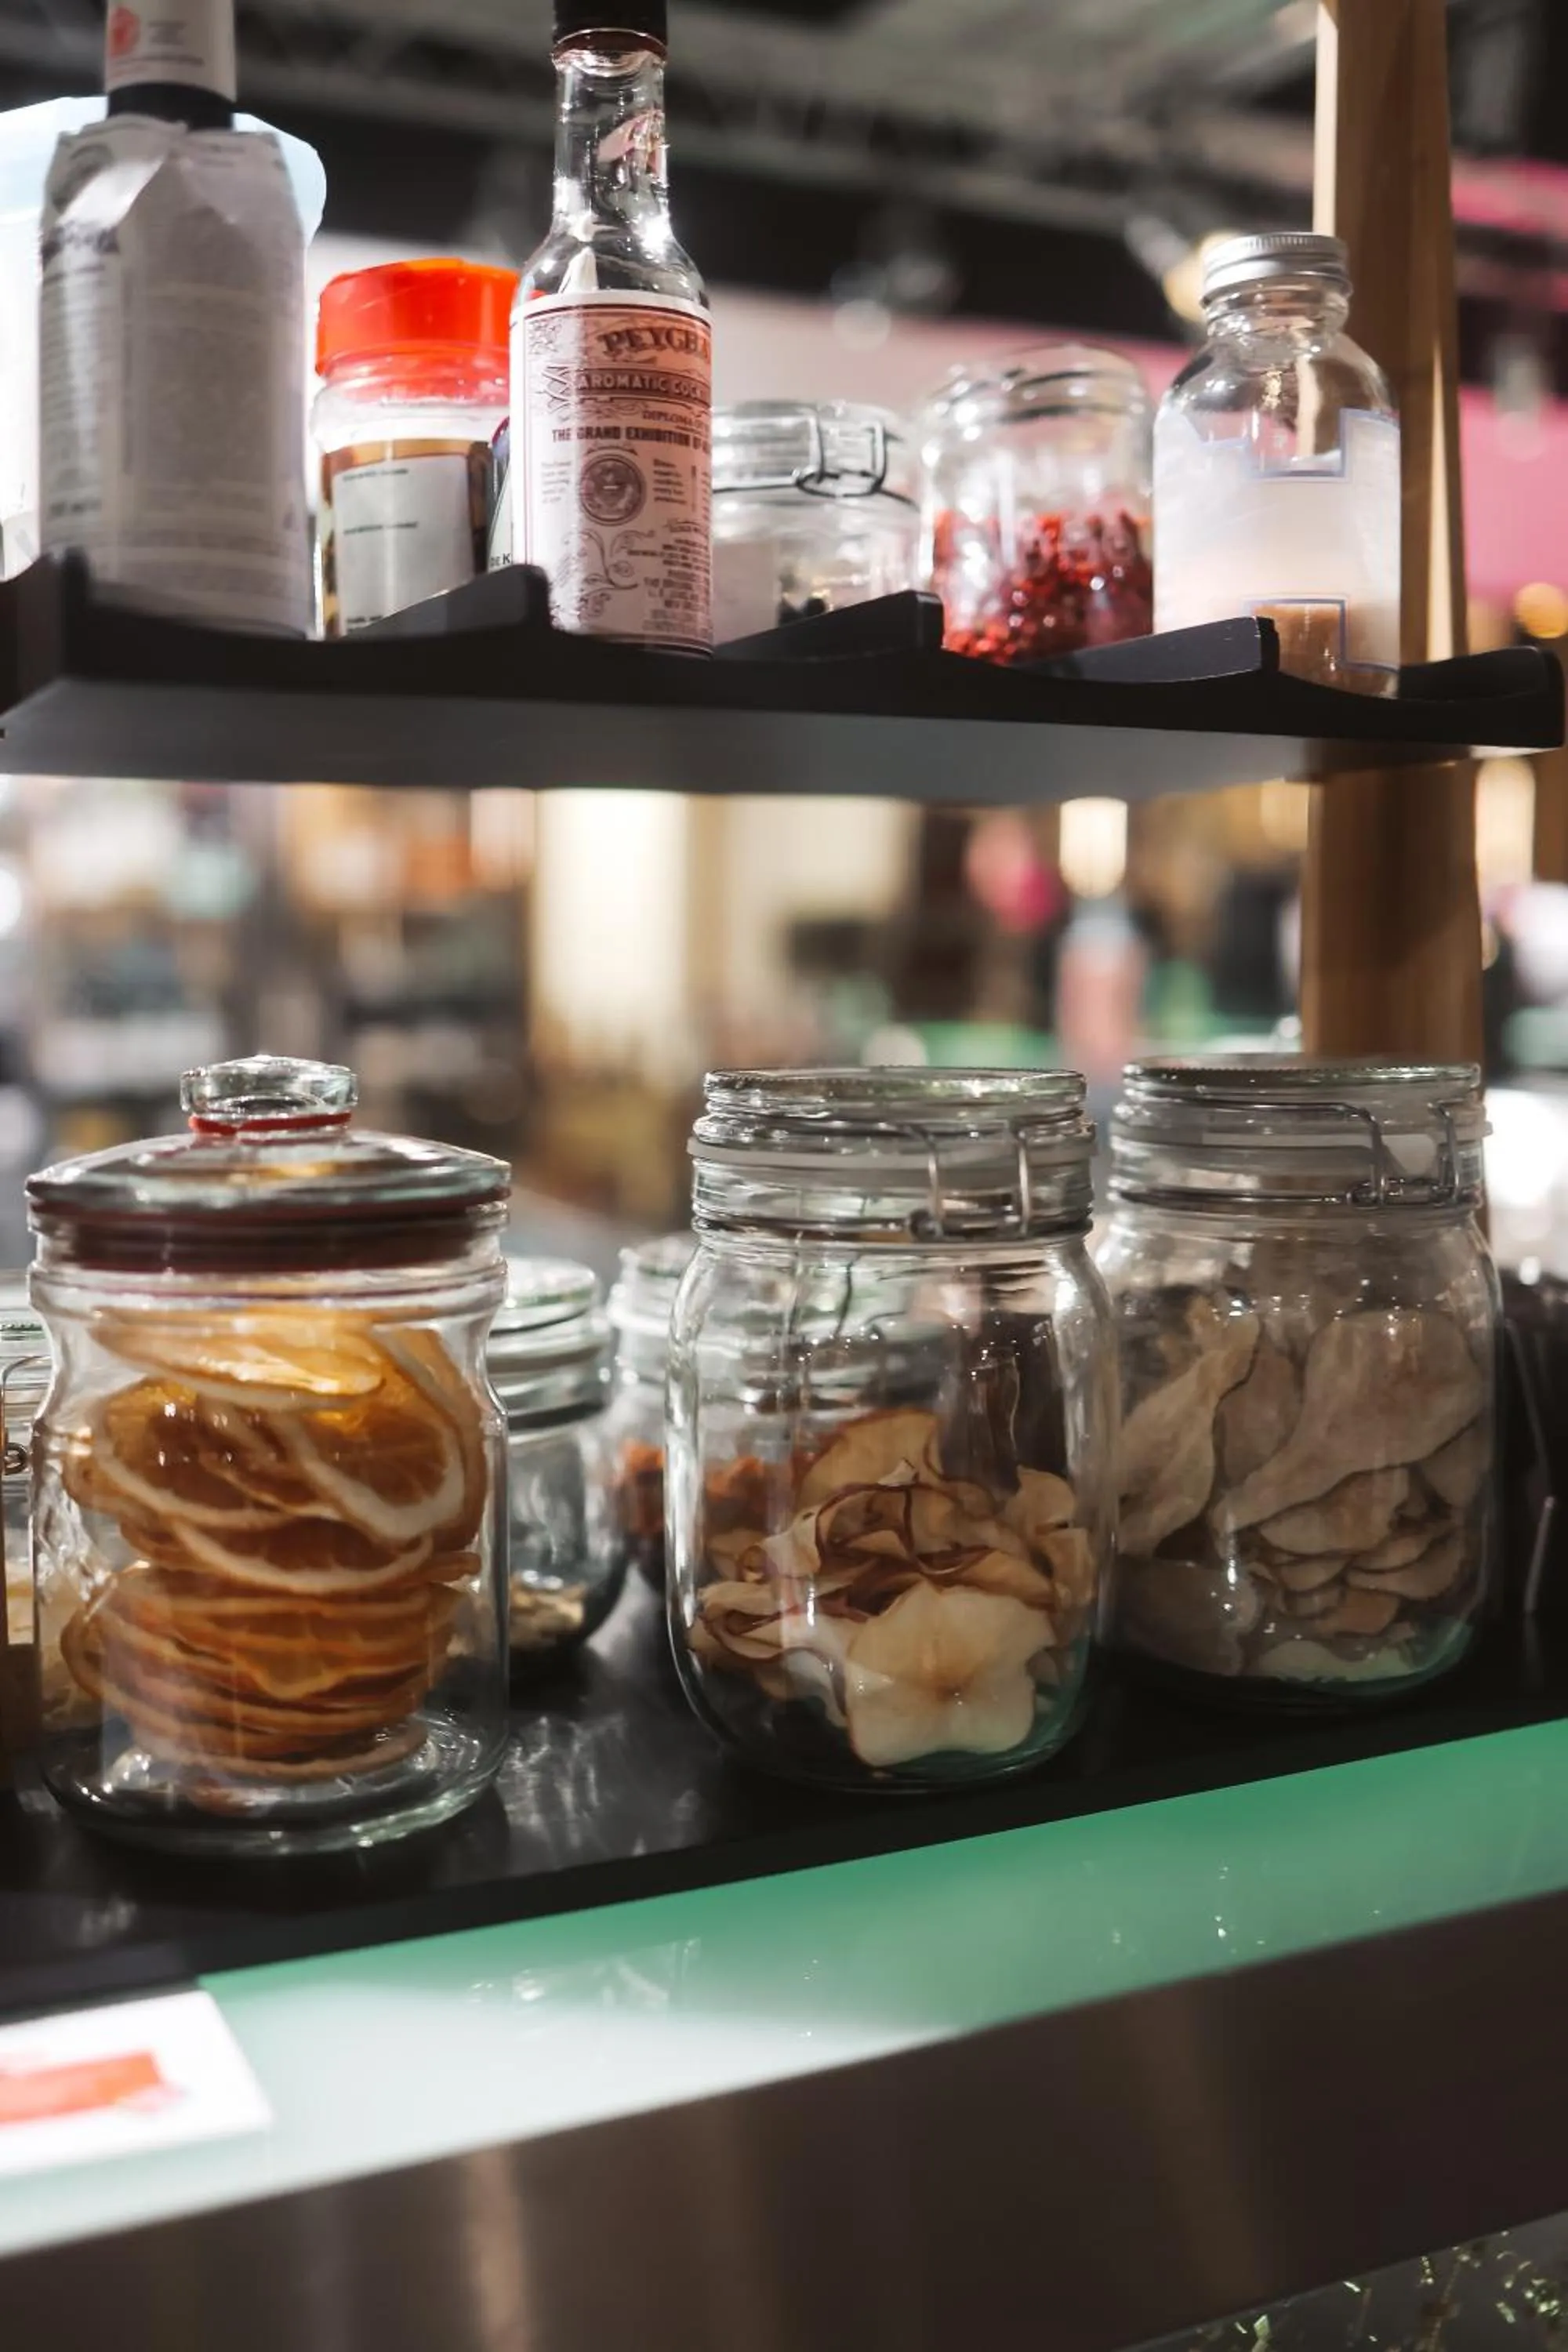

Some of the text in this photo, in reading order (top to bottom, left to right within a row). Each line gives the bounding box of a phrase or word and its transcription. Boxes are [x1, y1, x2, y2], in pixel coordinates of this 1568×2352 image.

[579, 373, 668, 391] AROMATIC
[552, 429, 572, 443] THE
[577, 426, 620, 440] GRAND
